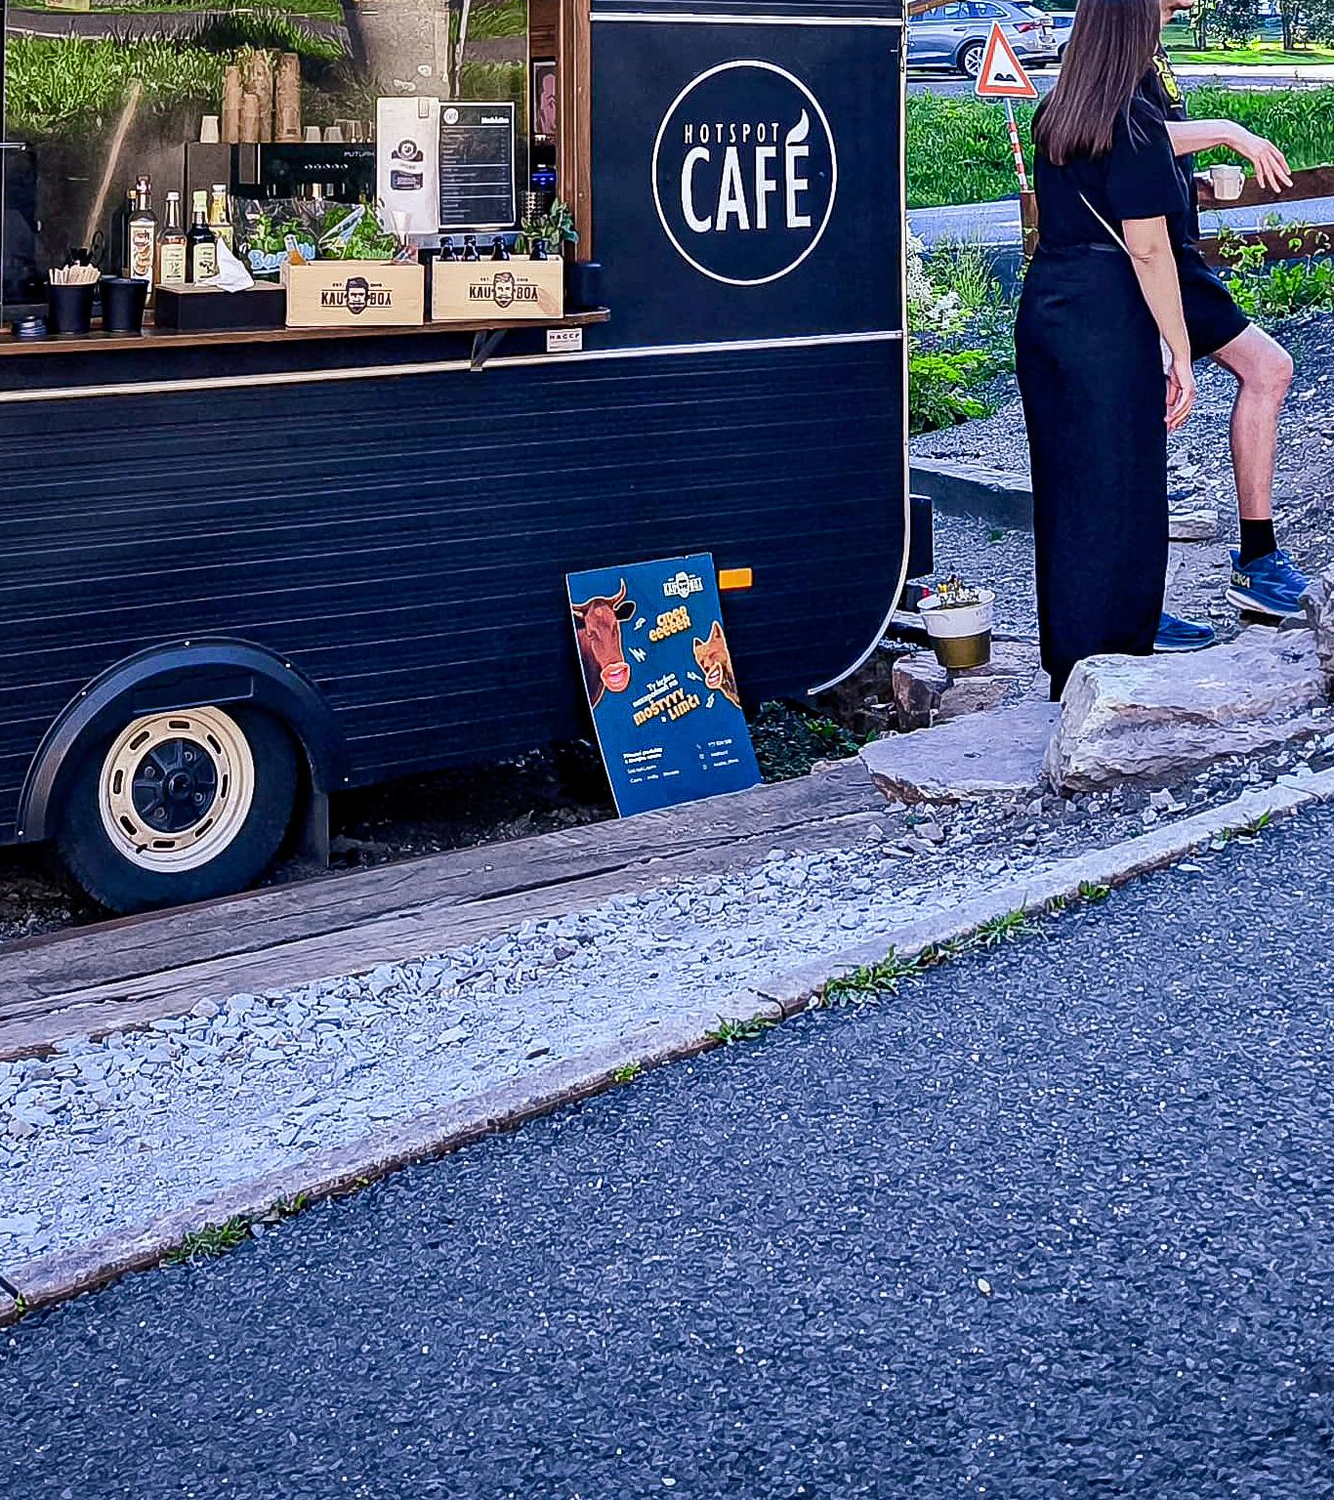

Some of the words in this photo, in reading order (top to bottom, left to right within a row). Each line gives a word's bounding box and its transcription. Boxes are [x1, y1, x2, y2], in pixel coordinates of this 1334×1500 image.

[683, 122, 780, 144] HOTSPOT
[321, 292, 345, 306] KAU
[469, 286, 492, 299] KAU
[1231, 570, 1251, 588] OKA
